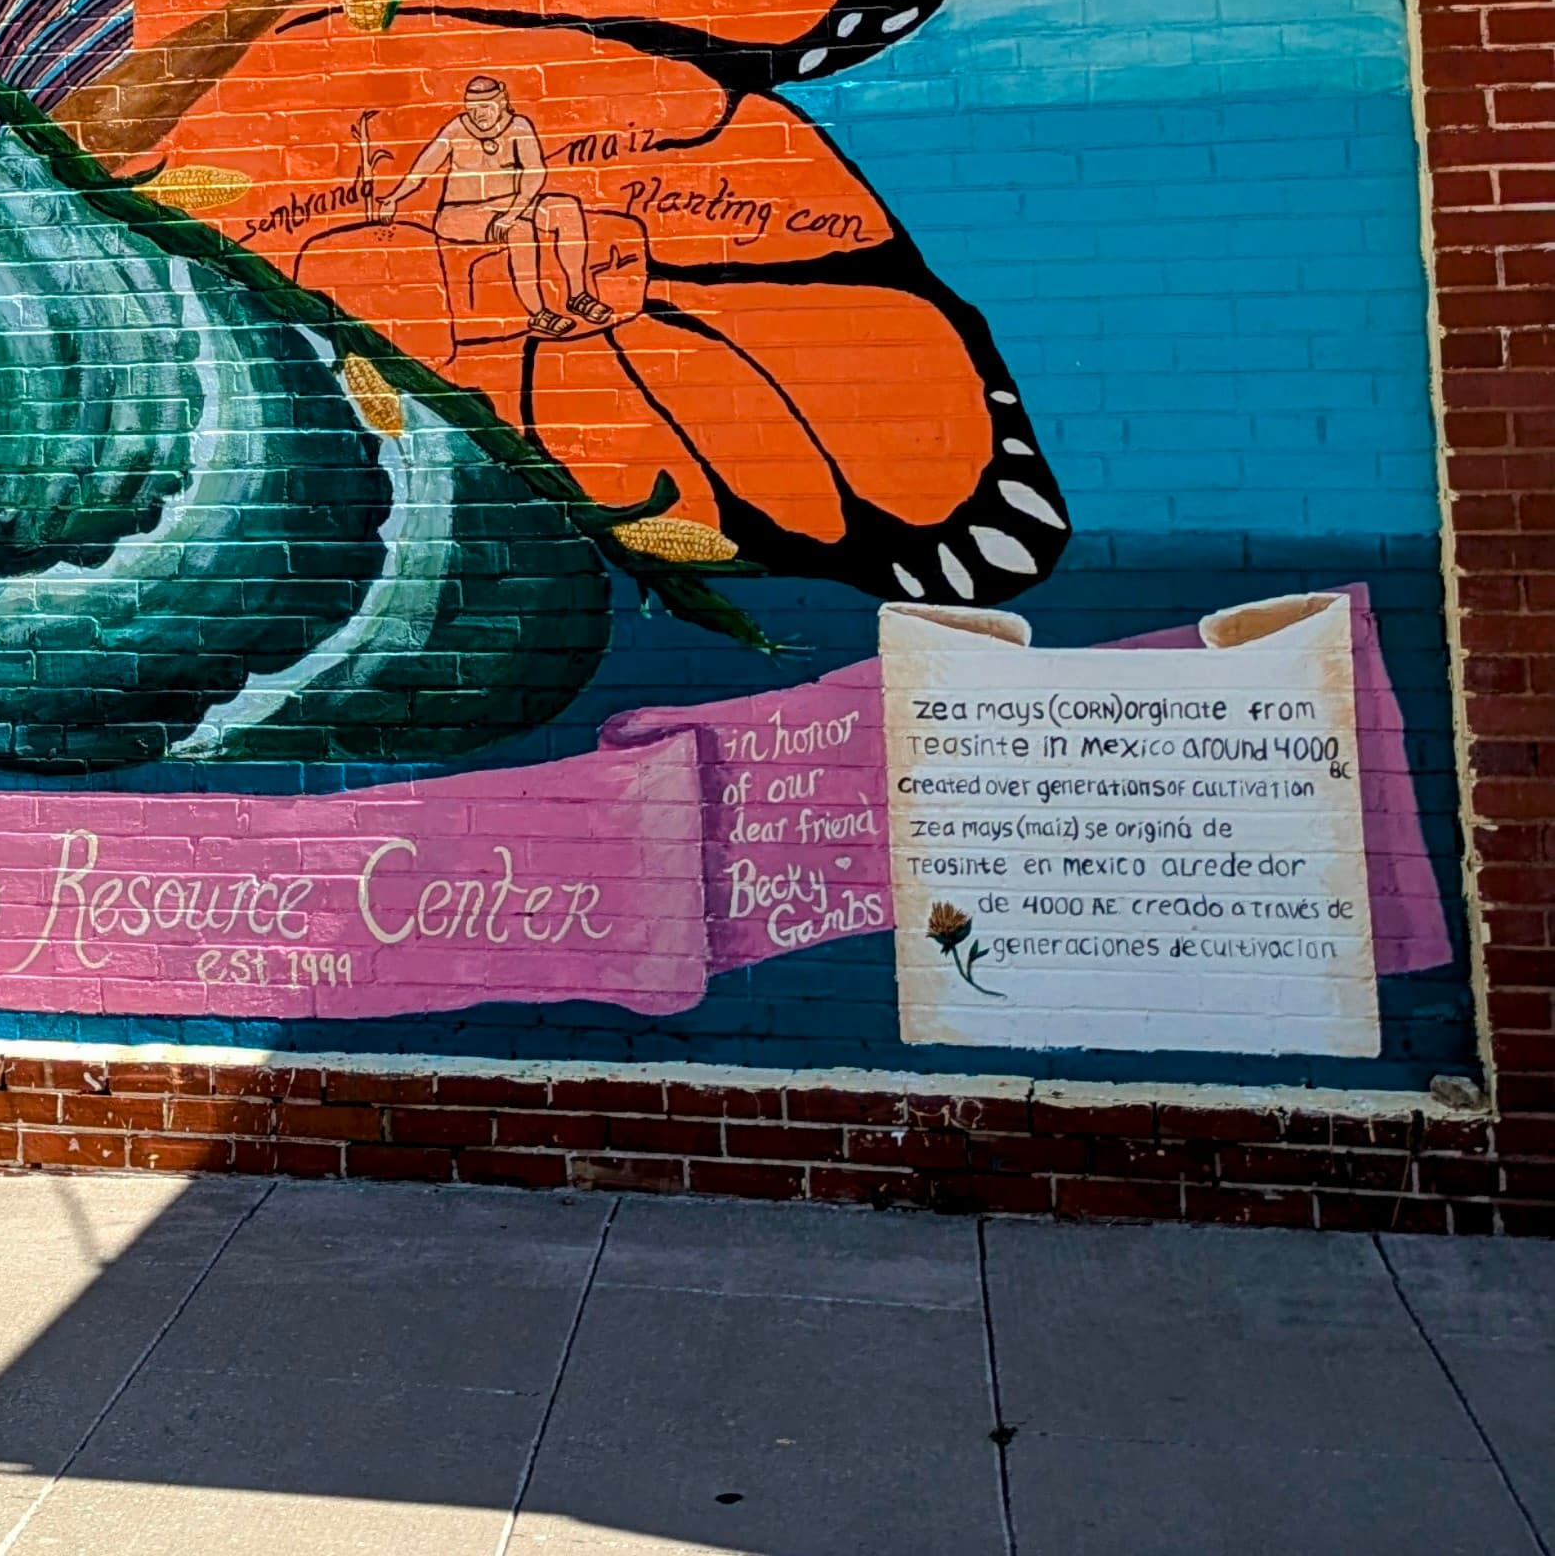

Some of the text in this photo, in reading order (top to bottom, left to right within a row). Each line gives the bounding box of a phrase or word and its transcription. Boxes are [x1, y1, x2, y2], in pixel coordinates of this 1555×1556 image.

[241, 166, 375, 240] sembrando
[620, 177, 874, 245] Planting corn
[976, 700, 1045, 727] mays
[1248, 700, 1316, 722] from
[723, 709, 860, 762] in honor
[1043, 734, 1067, 759] in
[1182, 736, 1268, 761] around
[1273, 735, 1340, 763] 4000
[722, 768, 825, 805] of our
[985, 779, 1031, 797] over
[729, 791, 881, 844] dear friend
[962, 820, 1013, 842] mays
[1085, 820, 1109, 840] se
[1202, 817, 1234, 838] de
[1023, 856, 1052, 875] en
[10, 828, 314, 974] Resource
[724, 858, 828, 918] Becky
[977, 892, 1010, 914] de
[1021, 895, 1084, 917] 4000
[1131, 894, 1224, 918] creado
[1230, 900, 1246, 917] a
[1327, 898, 1355, 920] de
[767, 890, 884, 947] Gambs
[992, 936, 1160, 963] generaciones
[1169, 936, 1196, 959] de
[287, 949, 354, 990] 1999
